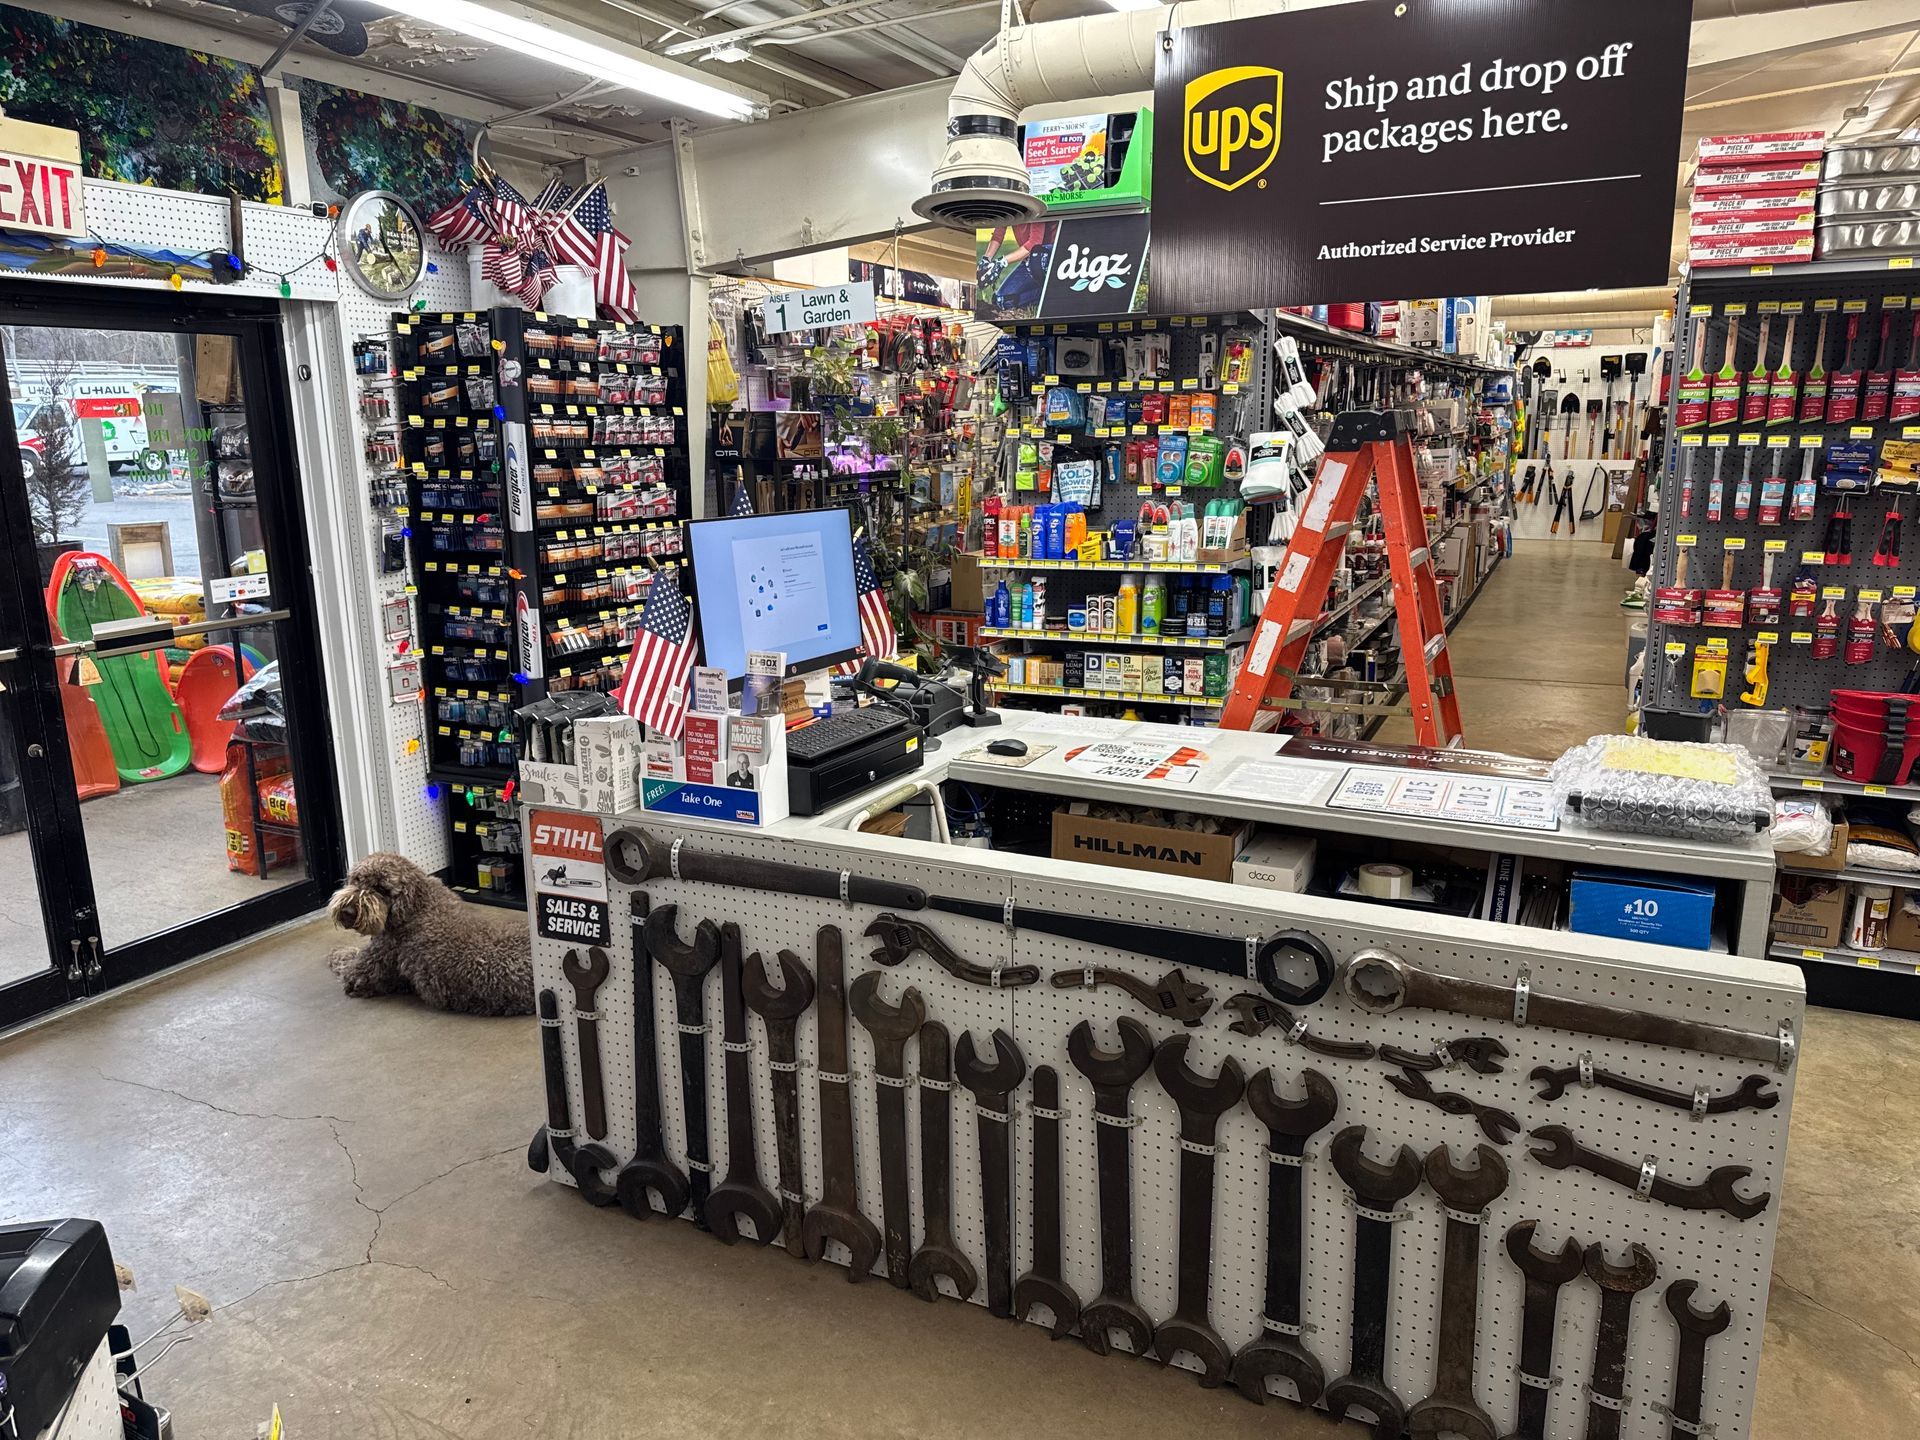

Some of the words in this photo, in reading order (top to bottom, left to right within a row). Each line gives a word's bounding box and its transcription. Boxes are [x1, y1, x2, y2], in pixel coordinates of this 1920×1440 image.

[1325, 74, 1400, 113] Ship
[1406, 62, 1476, 98] and
[1480, 56, 1567, 95] drop
[1576, 42, 1634, 81] off
[1322, 117, 1473, 163] packages
[1481, 106, 1570, 140] here.
[1028, 148, 1048, 158] Seed
[1051, 145, 1080, 155] Starter
[0, 158, 74, 229] EXIT
[1317, 236, 1417, 260] Authorized
[1419, 233, 1487, 253] Service
[1489, 227, 1576, 248] Provider
[1057, 244, 1132, 293] digz
[769, 294, 790, 303] AISLE
[801, 292, 836, 308] Lawn
[839, 289, 848, 303] &
[776, 307, 787, 331] 1
[803, 307, 850, 324] Garden
[1060, 468, 1092, 480] COLD
[1060, 479, 1092, 488] SHOWER
[508, 467, 522, 517] Energizer
[519, 619, 532, 672] Energizer
[732, 724, 762, 736] IN-TOWN
[732, 734, 762, 744] MOVES
[1308, 745, 1348, 757] here.
[1350, 748, 1427, 763] packages
[1092, 770, 1140, 778] RENT
[1102, 766, 1145, 774] NOW
[646, 784, 666, 802] FREE!
[680, 792, 700, 805] Take
[703, 795, 722, 808] One
[534, 824, 602, 852] STIHL
[1074, 834, 1202, 866] HILLMAN
[1248, 870, 1276, 882] deco
[1501, 858, 1512, 887] ULINE
[546, 898, 586, 918] SALES
[589, 906, 600, 920] &
[1624, 898, 1659, 918] #10
[548, 916, 600, 938] SERVICE
